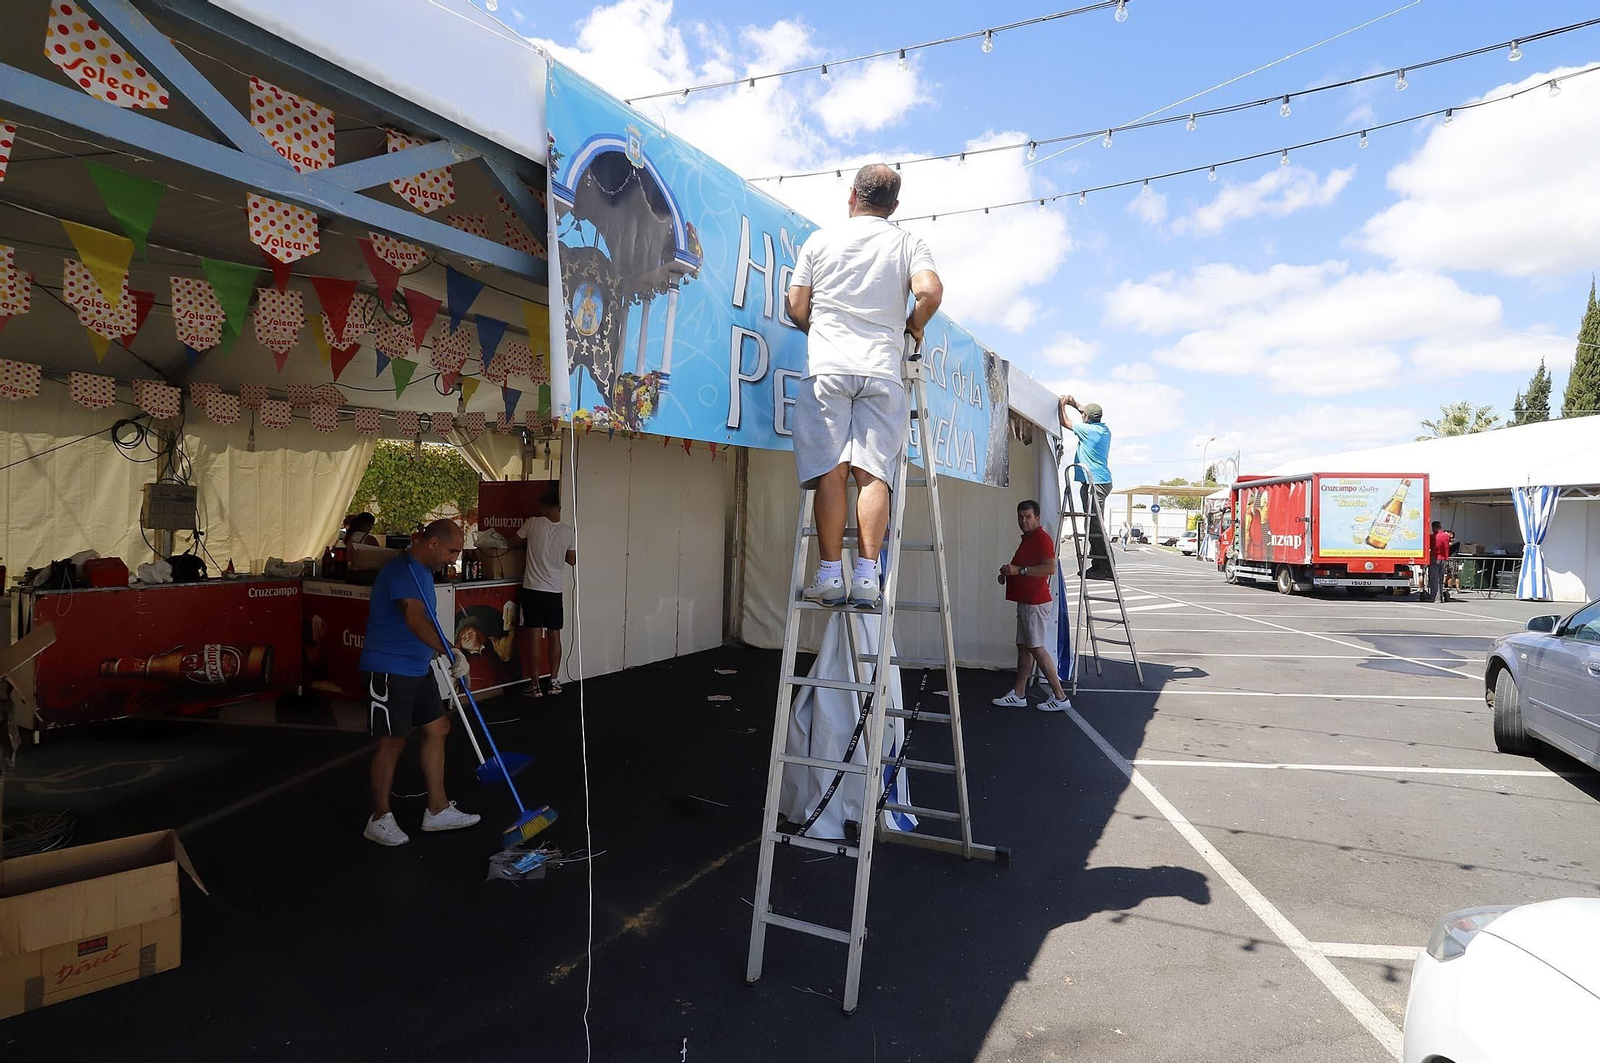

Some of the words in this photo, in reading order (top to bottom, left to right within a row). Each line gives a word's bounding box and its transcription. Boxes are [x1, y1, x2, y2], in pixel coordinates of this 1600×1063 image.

[63, 57, 150, 101] Solear
[401, 182, 446, 202] Solear
[261, 233, 310, 251] Solear
[383, 247, 419, 261] Solear
[74, 295, 116, 310] Solea
[181, 310, 219, 322] Solear
[267, 317, 299, 327] Solear
[88, 318, 128, 333] Solear
[184, 332, 216, 343] Solear
[264, 338, 292, 346] Solear
[395, 331, 414, 343] Solea
[380, 344, 403, 356] Solear
[443, 346, 466, 357] Solear
[434, 360, 456, 370] Solear
[0, 383, 32, 395] Solear
[78, 395, 109, 405] Solear
[147, 405, 175, 415] Solear
[211, 412, 235, 421] Solear
[1320, 484, 1358, 493] Cruzcampo
[483, 516, 528, 528] uzcampo
[248, 586, 298, 599] Cruzcampo
